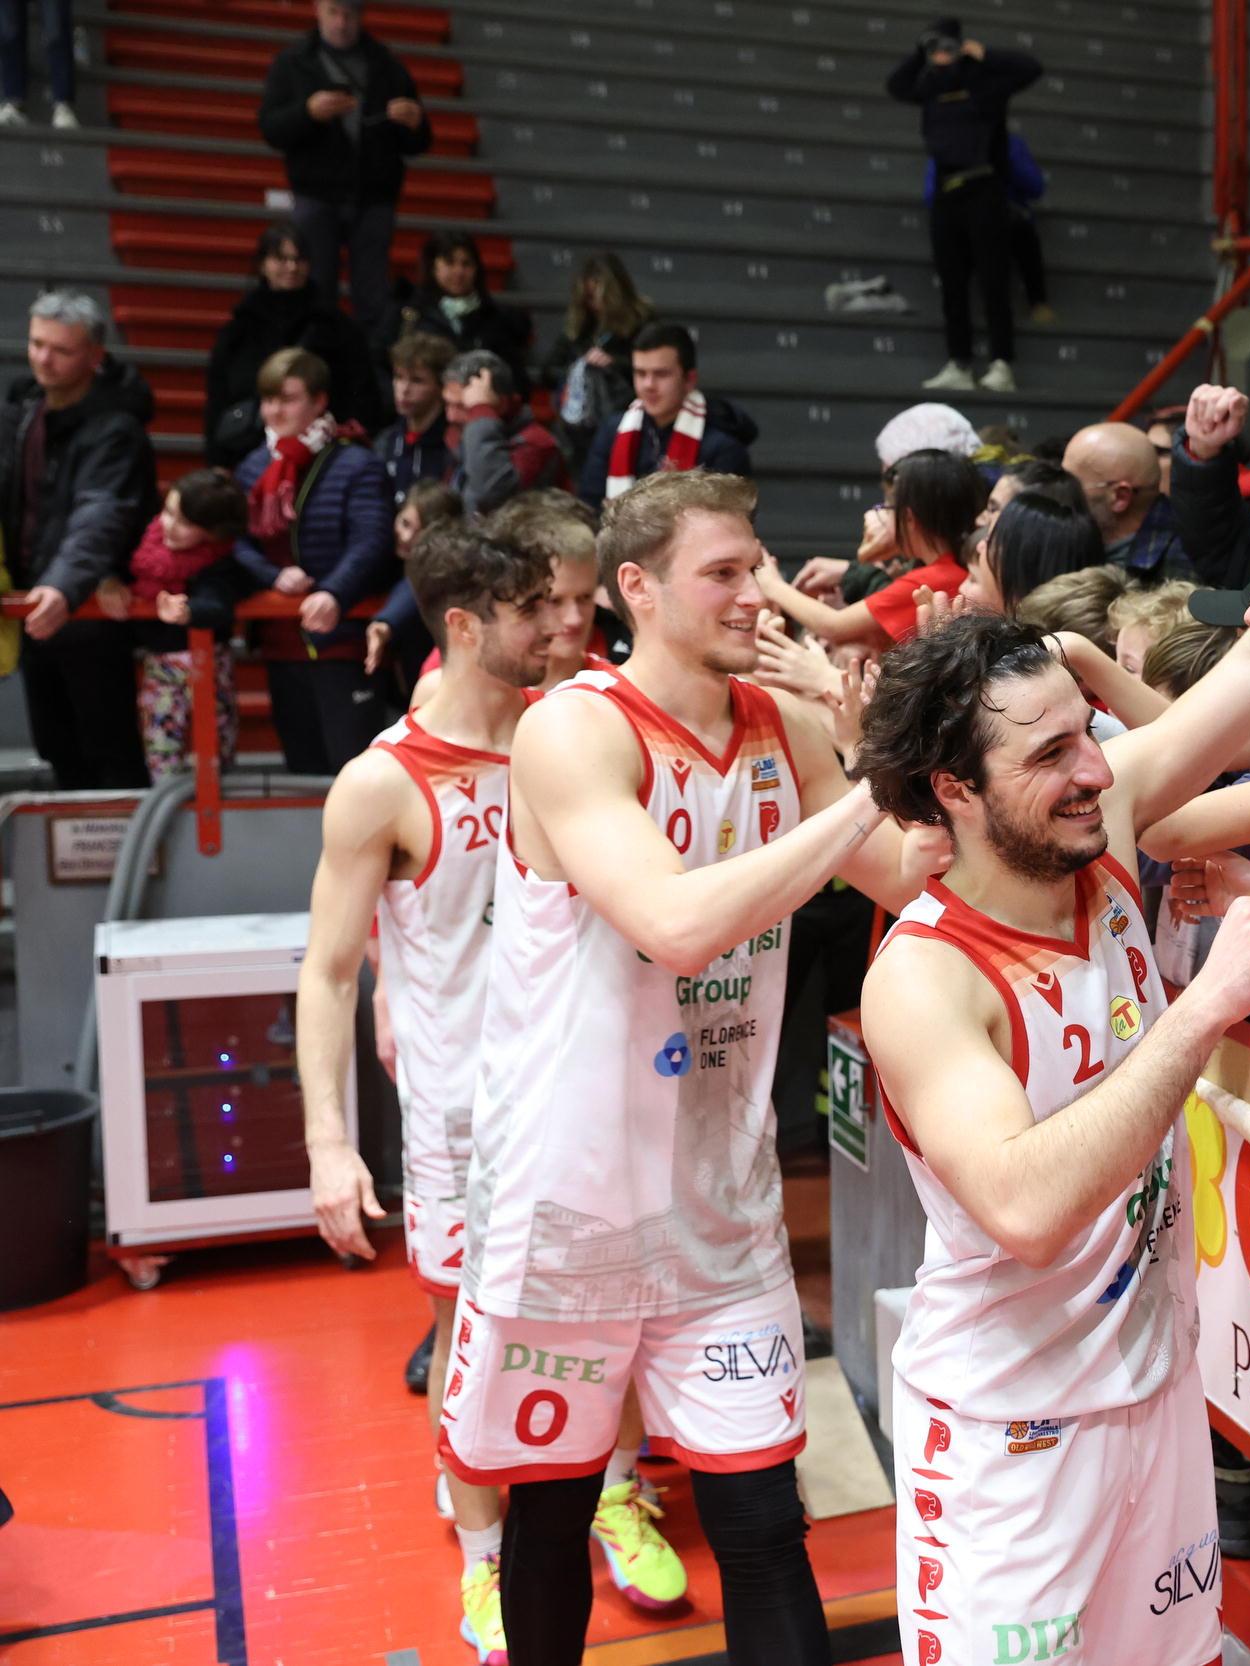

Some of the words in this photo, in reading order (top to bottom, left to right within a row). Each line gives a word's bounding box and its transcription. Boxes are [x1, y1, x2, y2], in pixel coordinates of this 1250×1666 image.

[457, 805, 503, 851] 20
[666, 808, 692, 855] 0
[676, 975, 753, 1007] Group
[700, 1050, 727, 1070] ONE
[1063, 1023, 1105, 1085] 2
[501, 1342, 607, 1384] DIFE
[702, 1333, 798, 1382] SILVA
[515, 1389, 569, 1447] 0
